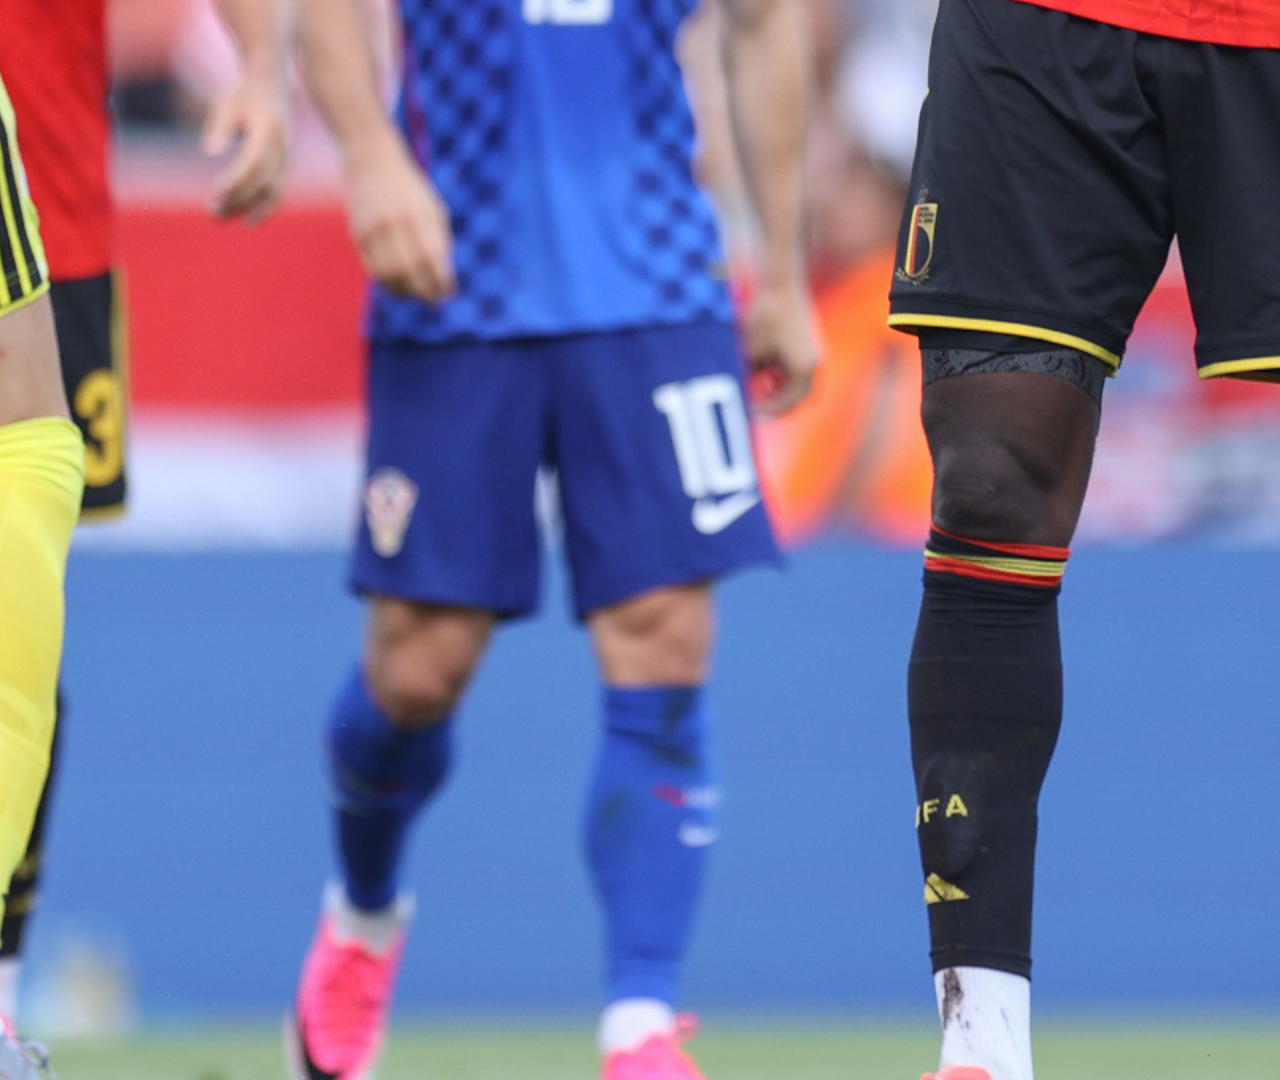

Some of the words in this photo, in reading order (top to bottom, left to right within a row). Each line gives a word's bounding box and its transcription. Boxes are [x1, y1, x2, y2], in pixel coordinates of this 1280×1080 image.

[75, 370, 123, 487] 3
[652, 374, 754, 499] 10
[915, 793, 968, 829] FA
